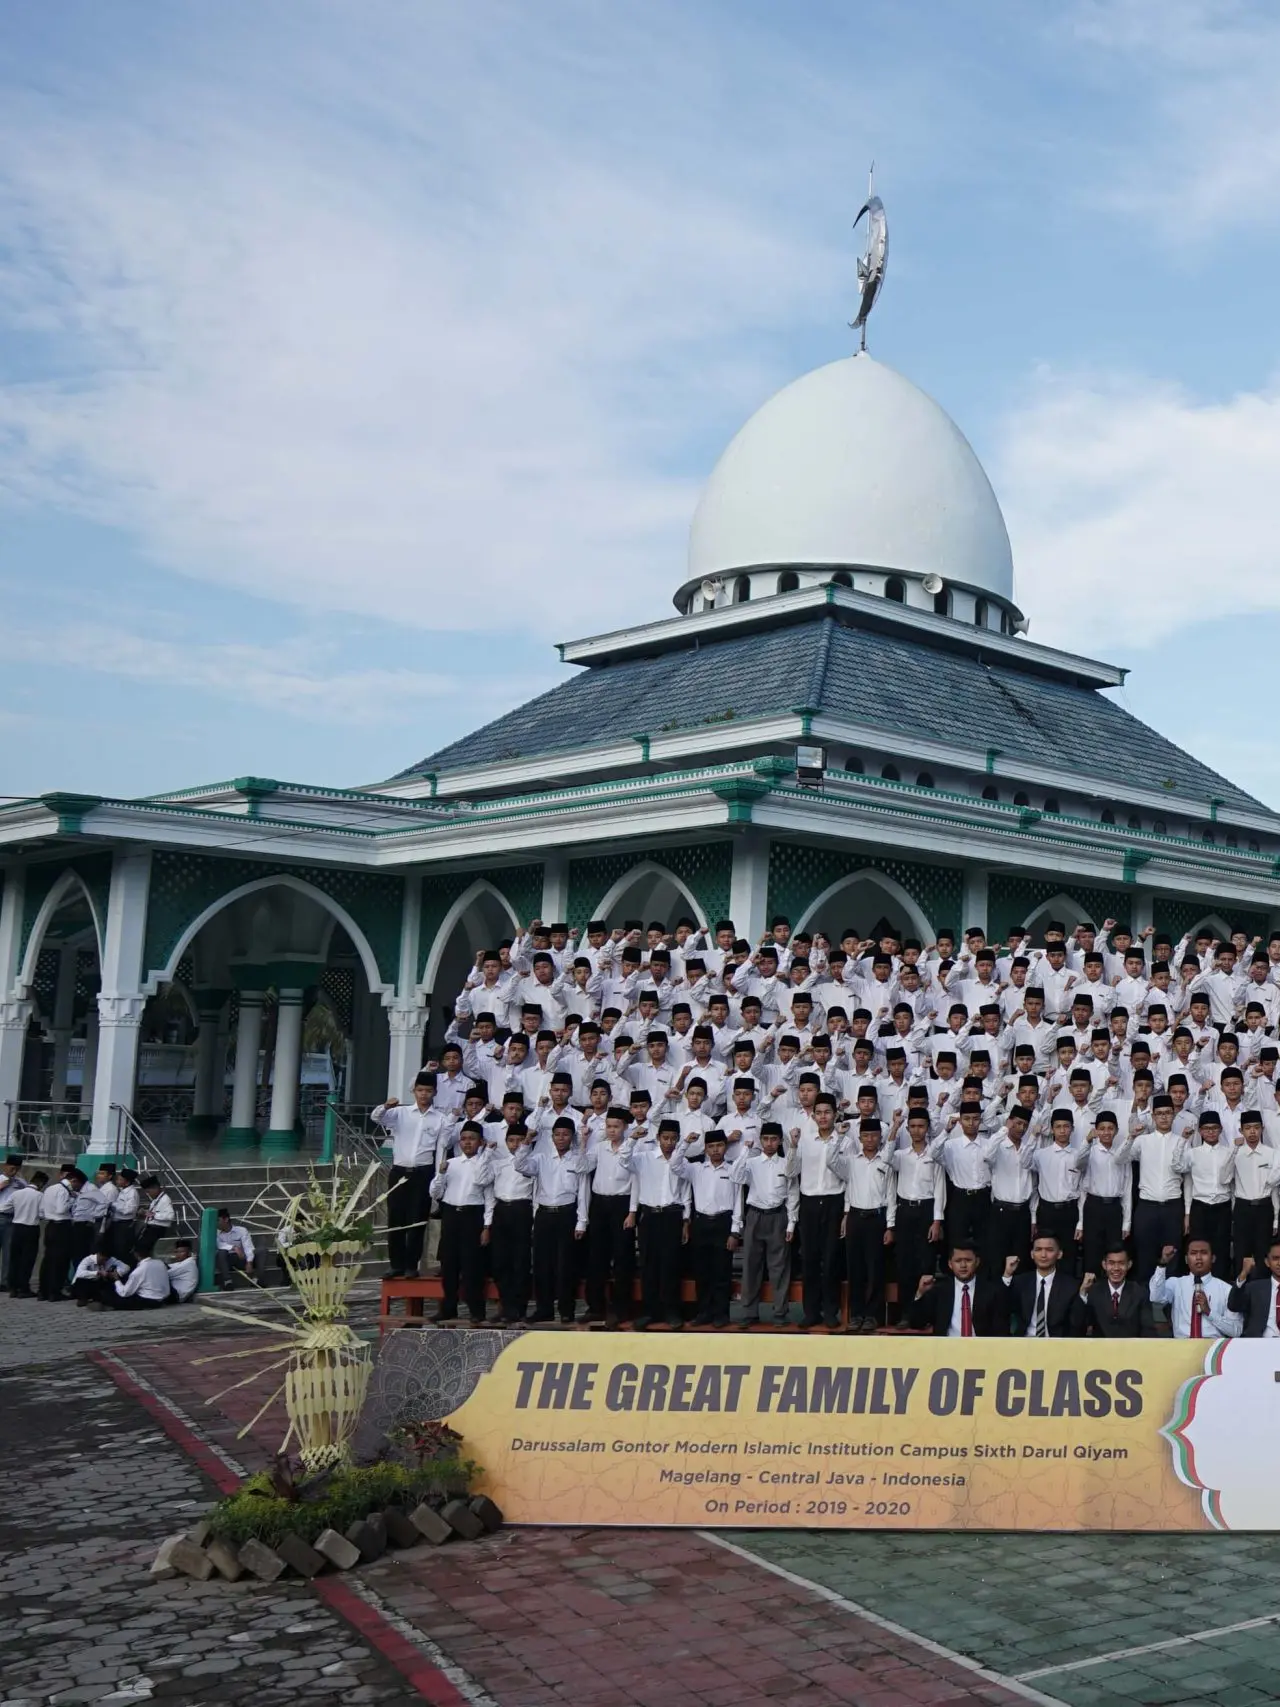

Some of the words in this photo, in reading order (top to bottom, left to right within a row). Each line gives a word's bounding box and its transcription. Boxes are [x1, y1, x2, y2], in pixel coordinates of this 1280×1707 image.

[515, 1361, 599, 1411] THE
[605, 1363, 751, 1413] GREAT
[756, 1365, 920, 1415] FAMILY
[928, 1367, 986, 1417] OF
[995, 1369, 1144, 1418] CLASS
[511, 1438, 606, 1453] Darussalam
[611, 1440, 669, 1454] Gontor
[674, 1440, 738, 1455] Modern
[743, 1441, 802, 1456] Islamic
[807, 1442, 894, 1457] Institution
[900, 1443, 968, 1460] Campus
[974, 1444, 1016, 1459] Sixth
[1022, 1445, 1067, 1459] Darul
[1073, 1446, 1129, 1461] Qiyam
[660, 1469, 741, 1485] Magelang
[759, 1471, 820, 1485] Central
[826, 1472, 865, 1485] Java
[883, 1472, 966, 1487] Indonesia
[705, 1499, 729, 1513] On
[735, 1500, 790, 1514] Period
[806, 1501, 848, 1515] 2019
[865, 1502, 911, 1515] 2020
